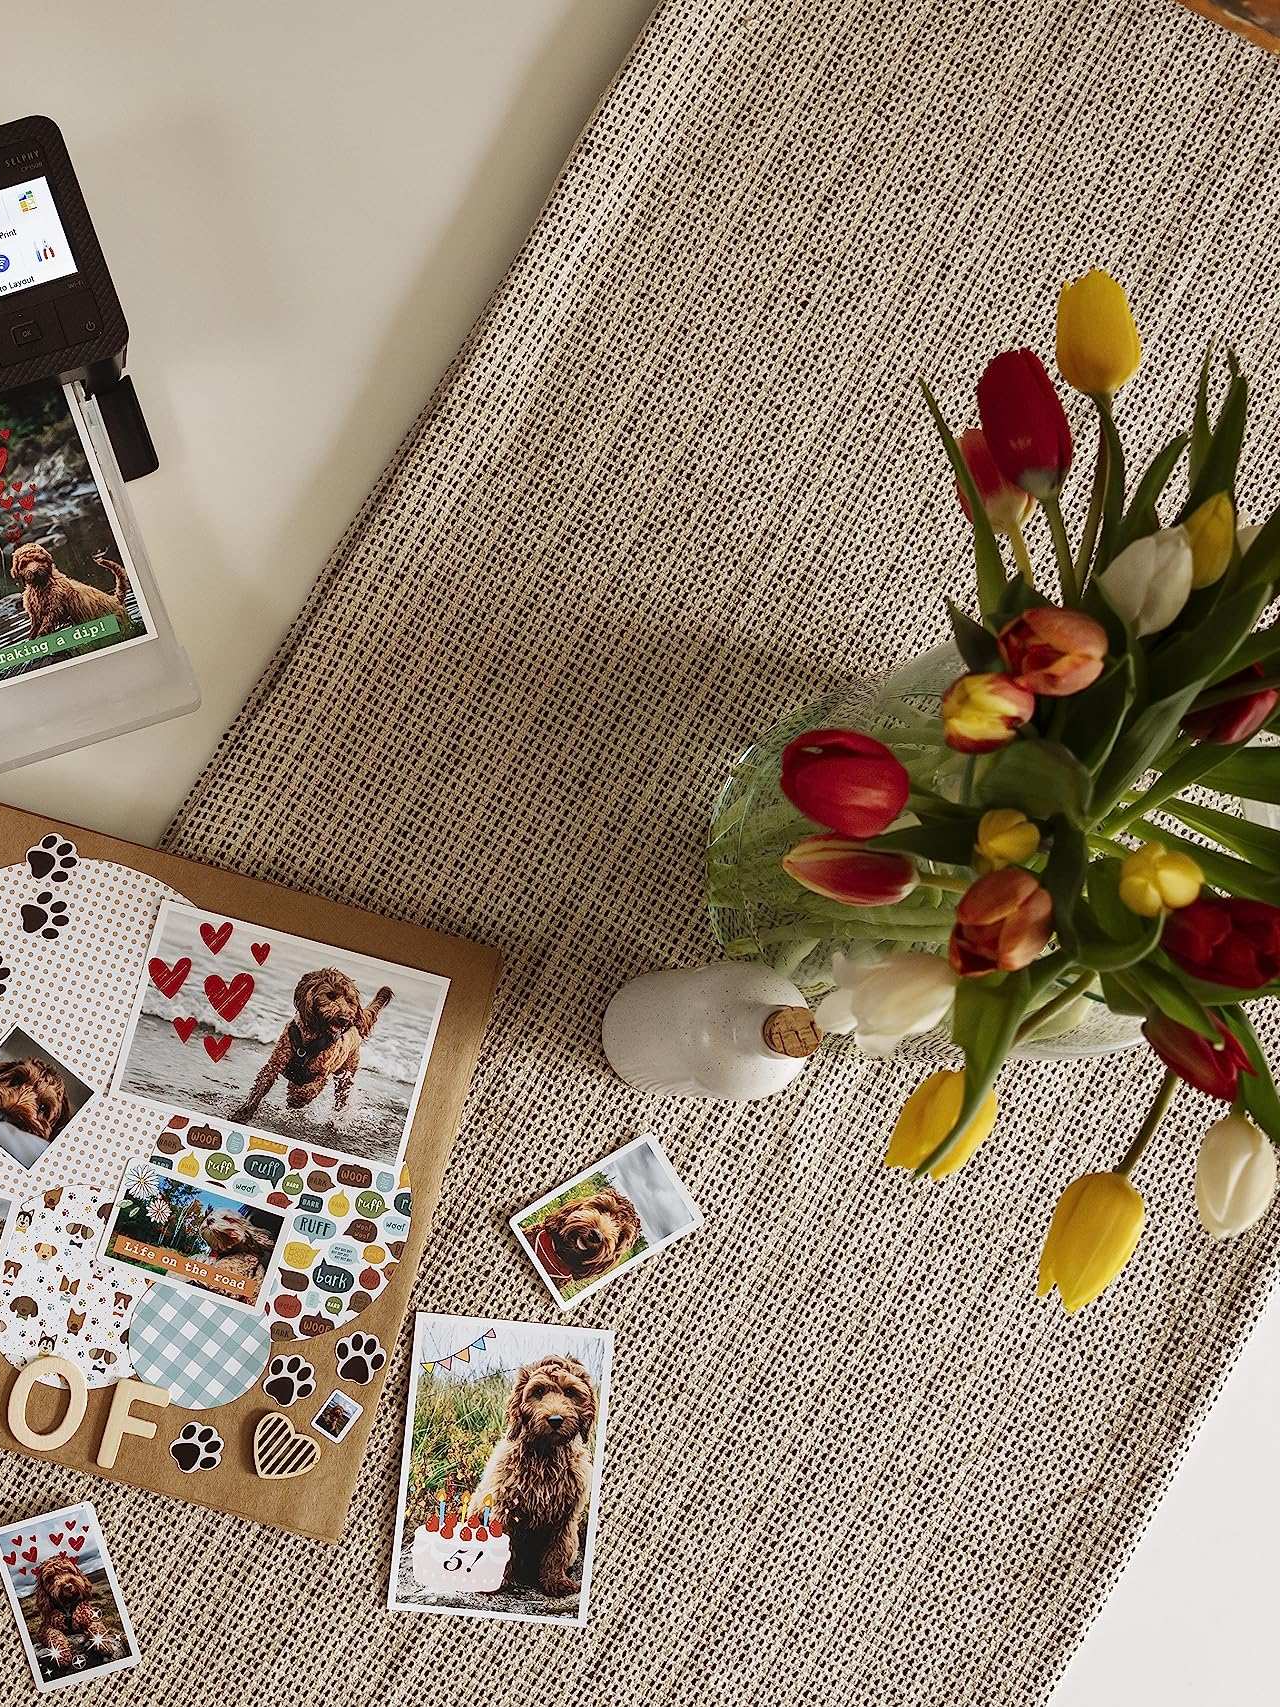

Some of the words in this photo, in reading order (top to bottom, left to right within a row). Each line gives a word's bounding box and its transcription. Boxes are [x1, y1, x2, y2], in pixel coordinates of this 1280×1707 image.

[0, 228, 18, 241] Print
[9, 275, 35, 291] Layout
[56, 637, 66, 646] a
[72, 621, 106, 641] dip!
[191, 1131, 219, 1145] WOOF
[207, 1161, 232, 1175] ruff
[250, 1161, 279, 1178] ruff
[340, 1170, 369, 1184] WOOF
[235, 1183, 256, 1194] woof
[357, 1196, 383, 1213] ruff
[299, 1216, 331, 1237] RUFF
[385, 1222, 407, 1232] woof
[123, 1241, 156, 1260] Life
[161, 1255, 178, 1267] on
[184, 1262, 208, 1277] the
[214, 1273, 247, 1291] road
[316, 1267, 348, 1290] bark
[442, 1549, 485, 1573] 5!
